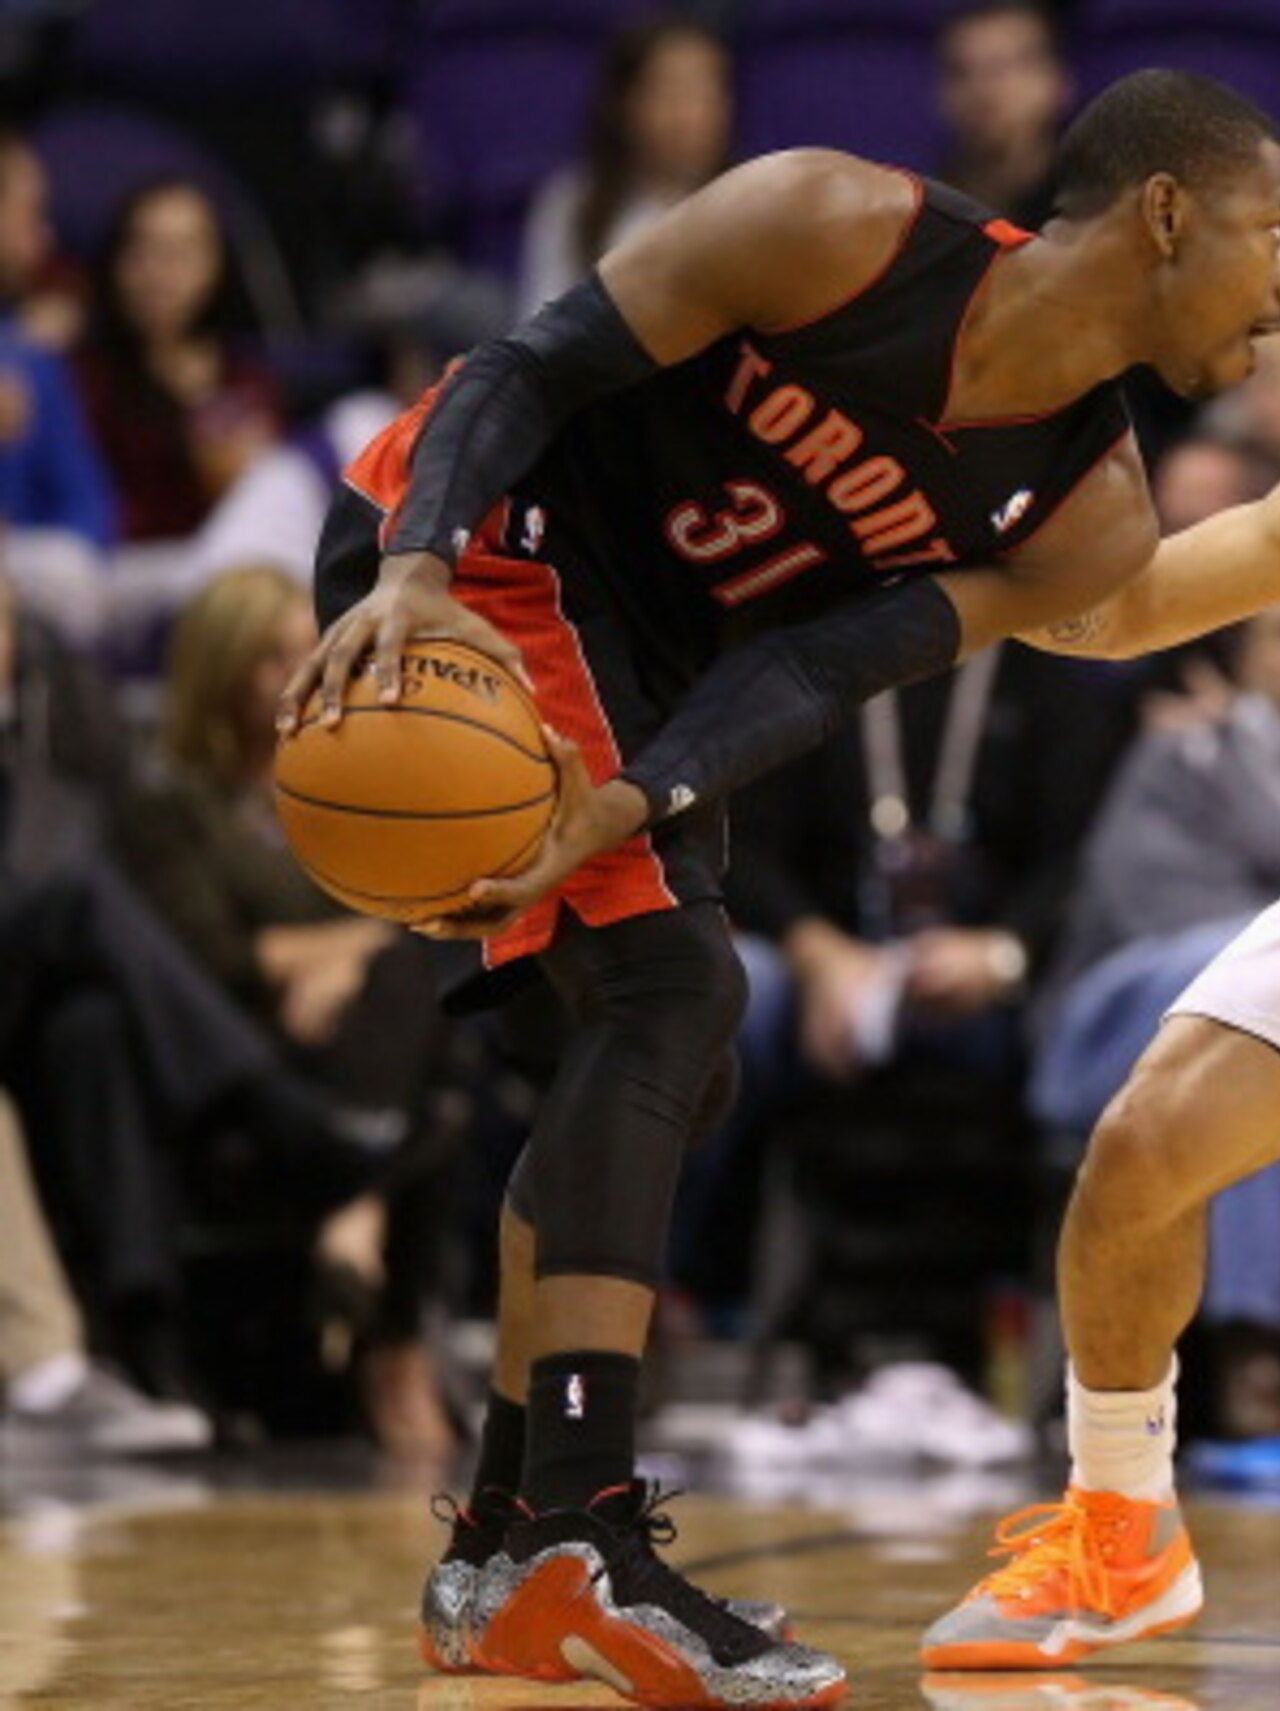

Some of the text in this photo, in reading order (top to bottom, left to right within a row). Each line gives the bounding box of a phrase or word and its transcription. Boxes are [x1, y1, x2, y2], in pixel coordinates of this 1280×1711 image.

[724, 341, 957, 569] TORONT
[665, 479, 827, 606] 31
[400, 655, 501, 698] SPAL
